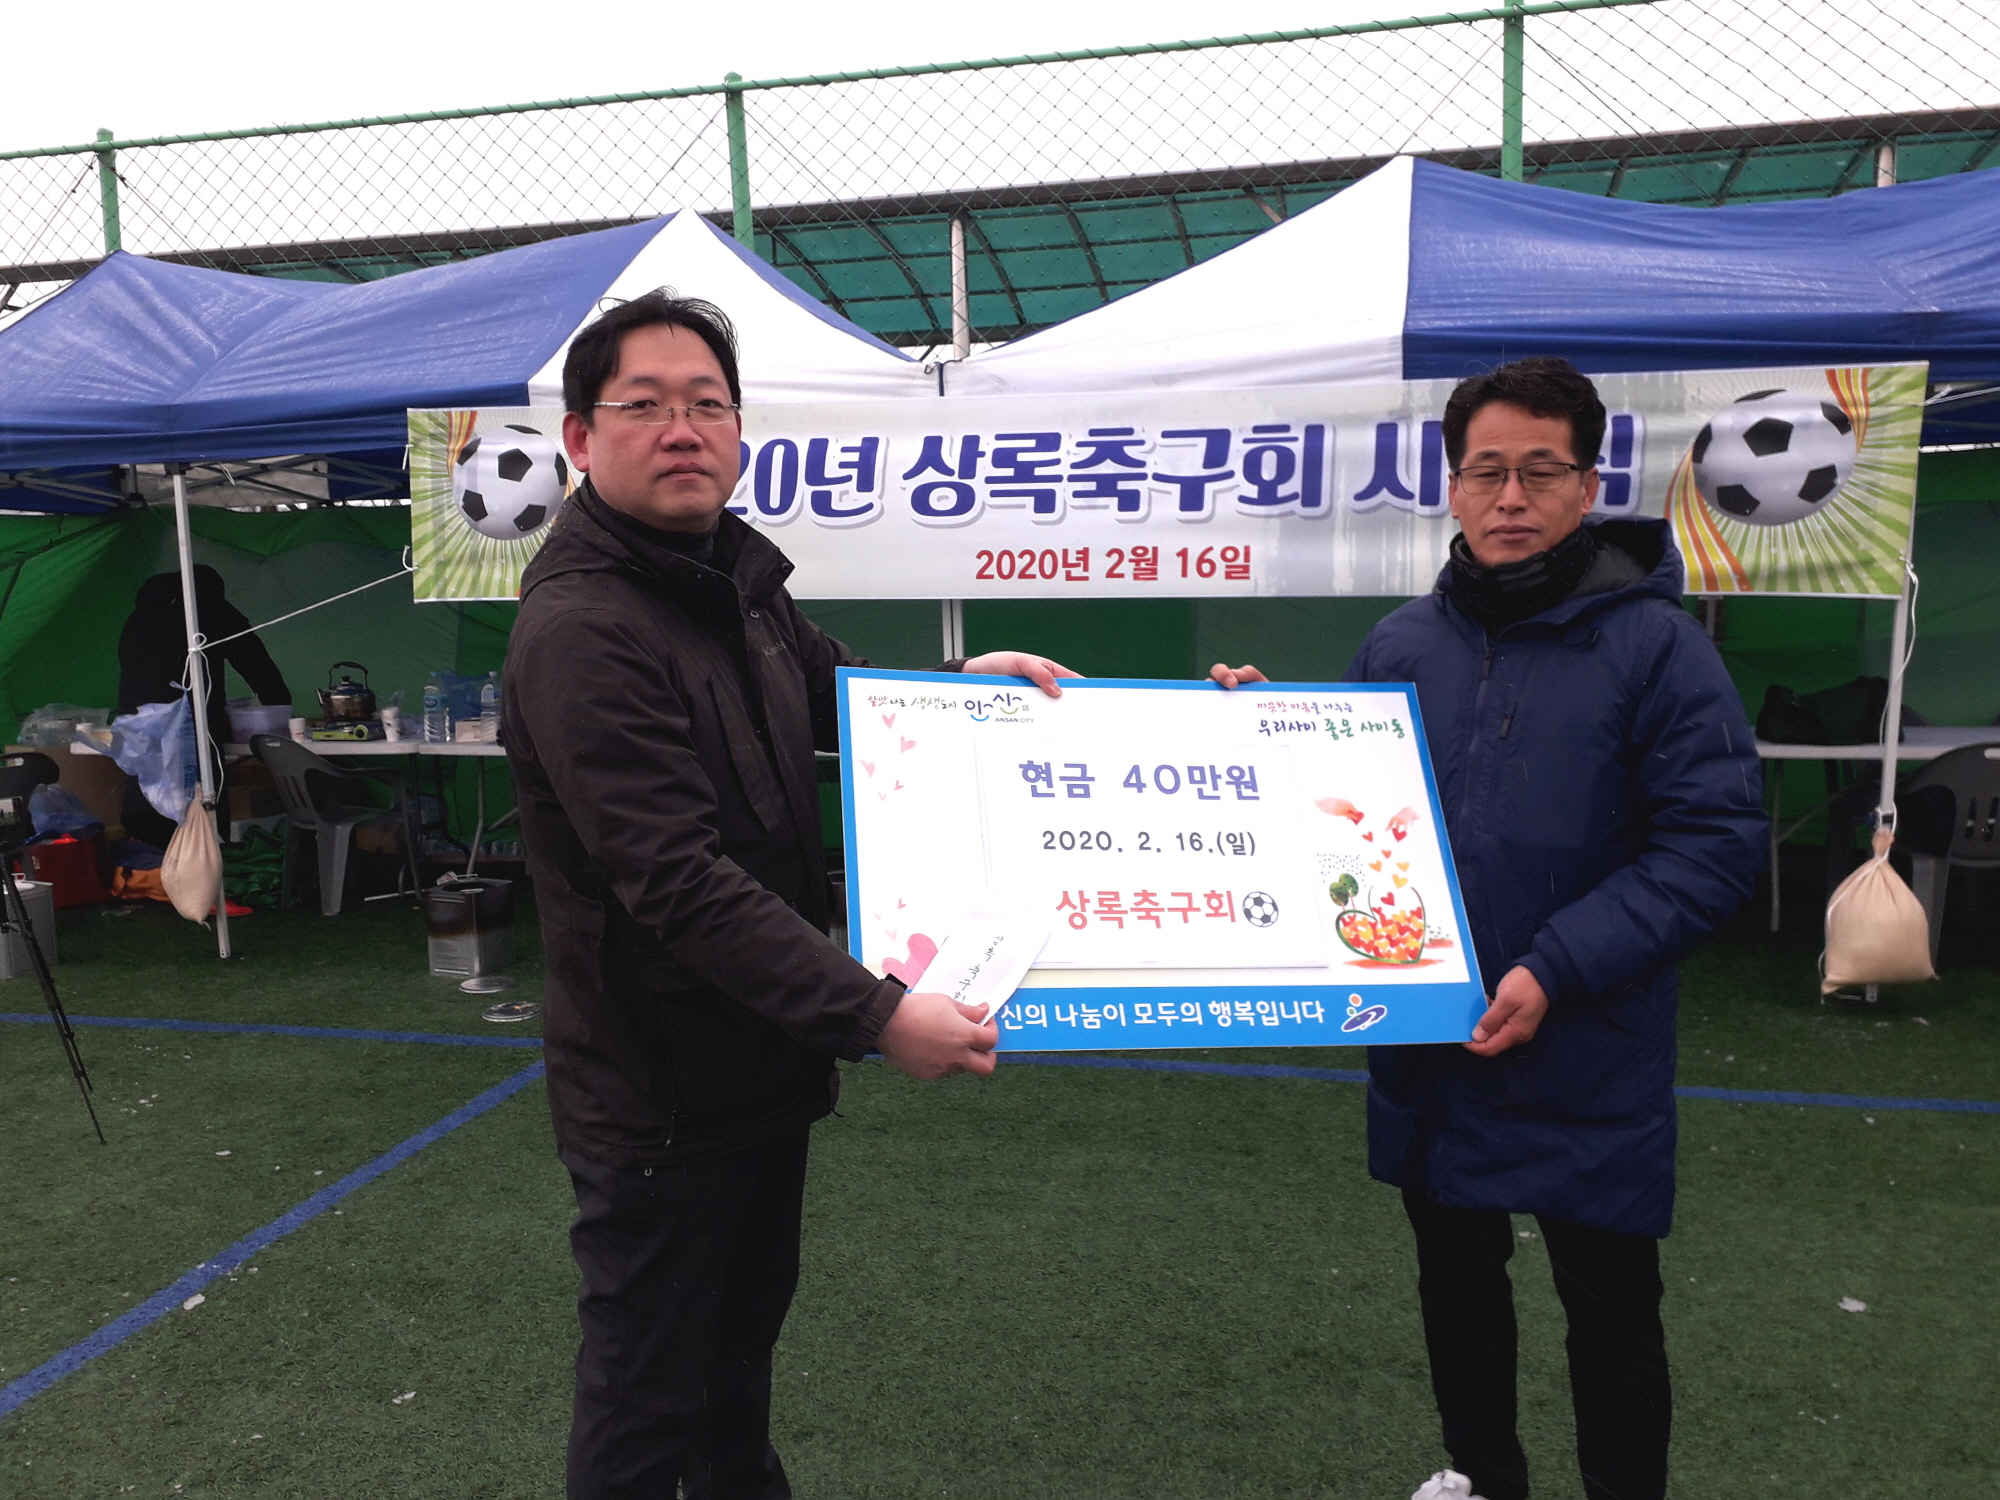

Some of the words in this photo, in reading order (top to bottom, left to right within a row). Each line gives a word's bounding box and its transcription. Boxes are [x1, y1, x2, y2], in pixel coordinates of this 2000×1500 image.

[902, 427, 1325, 516] 상록축구회
[975, 547, 1090, 582] 2020년
[1105, 546, 1161, 580] 2월
[1178, 546, 1252, 579] 16일
[868, 695, 888, 707] 살맛
[890, 699, 907, 708] 나는
[1257, 701, 1287, 714] 따뜻한
[1290, 702, 1321, 715] 마음을
[1323, 702, 1354, 714] 나누는
[1324, 718, 1354, 741] 좋은
[1018, 760, 1096, 799] 현금
[1122, 764, 1261, 801] 40만원
[1041, 830, 1123, 853] 2020.
[1137, 831, 1162, 853] 2.
[1175, 831, 1256, 856] 16.(일)
[1055, 889, 1237, 930] 상록축구회
[997, 1003, 1049, 1030] 신의
[1055, 1002, 1127, 1029] 나눔이
[1133, 1002, 1204, 1027] 모두의
[1208, 1000, 1326, 1028] 행복입니다
